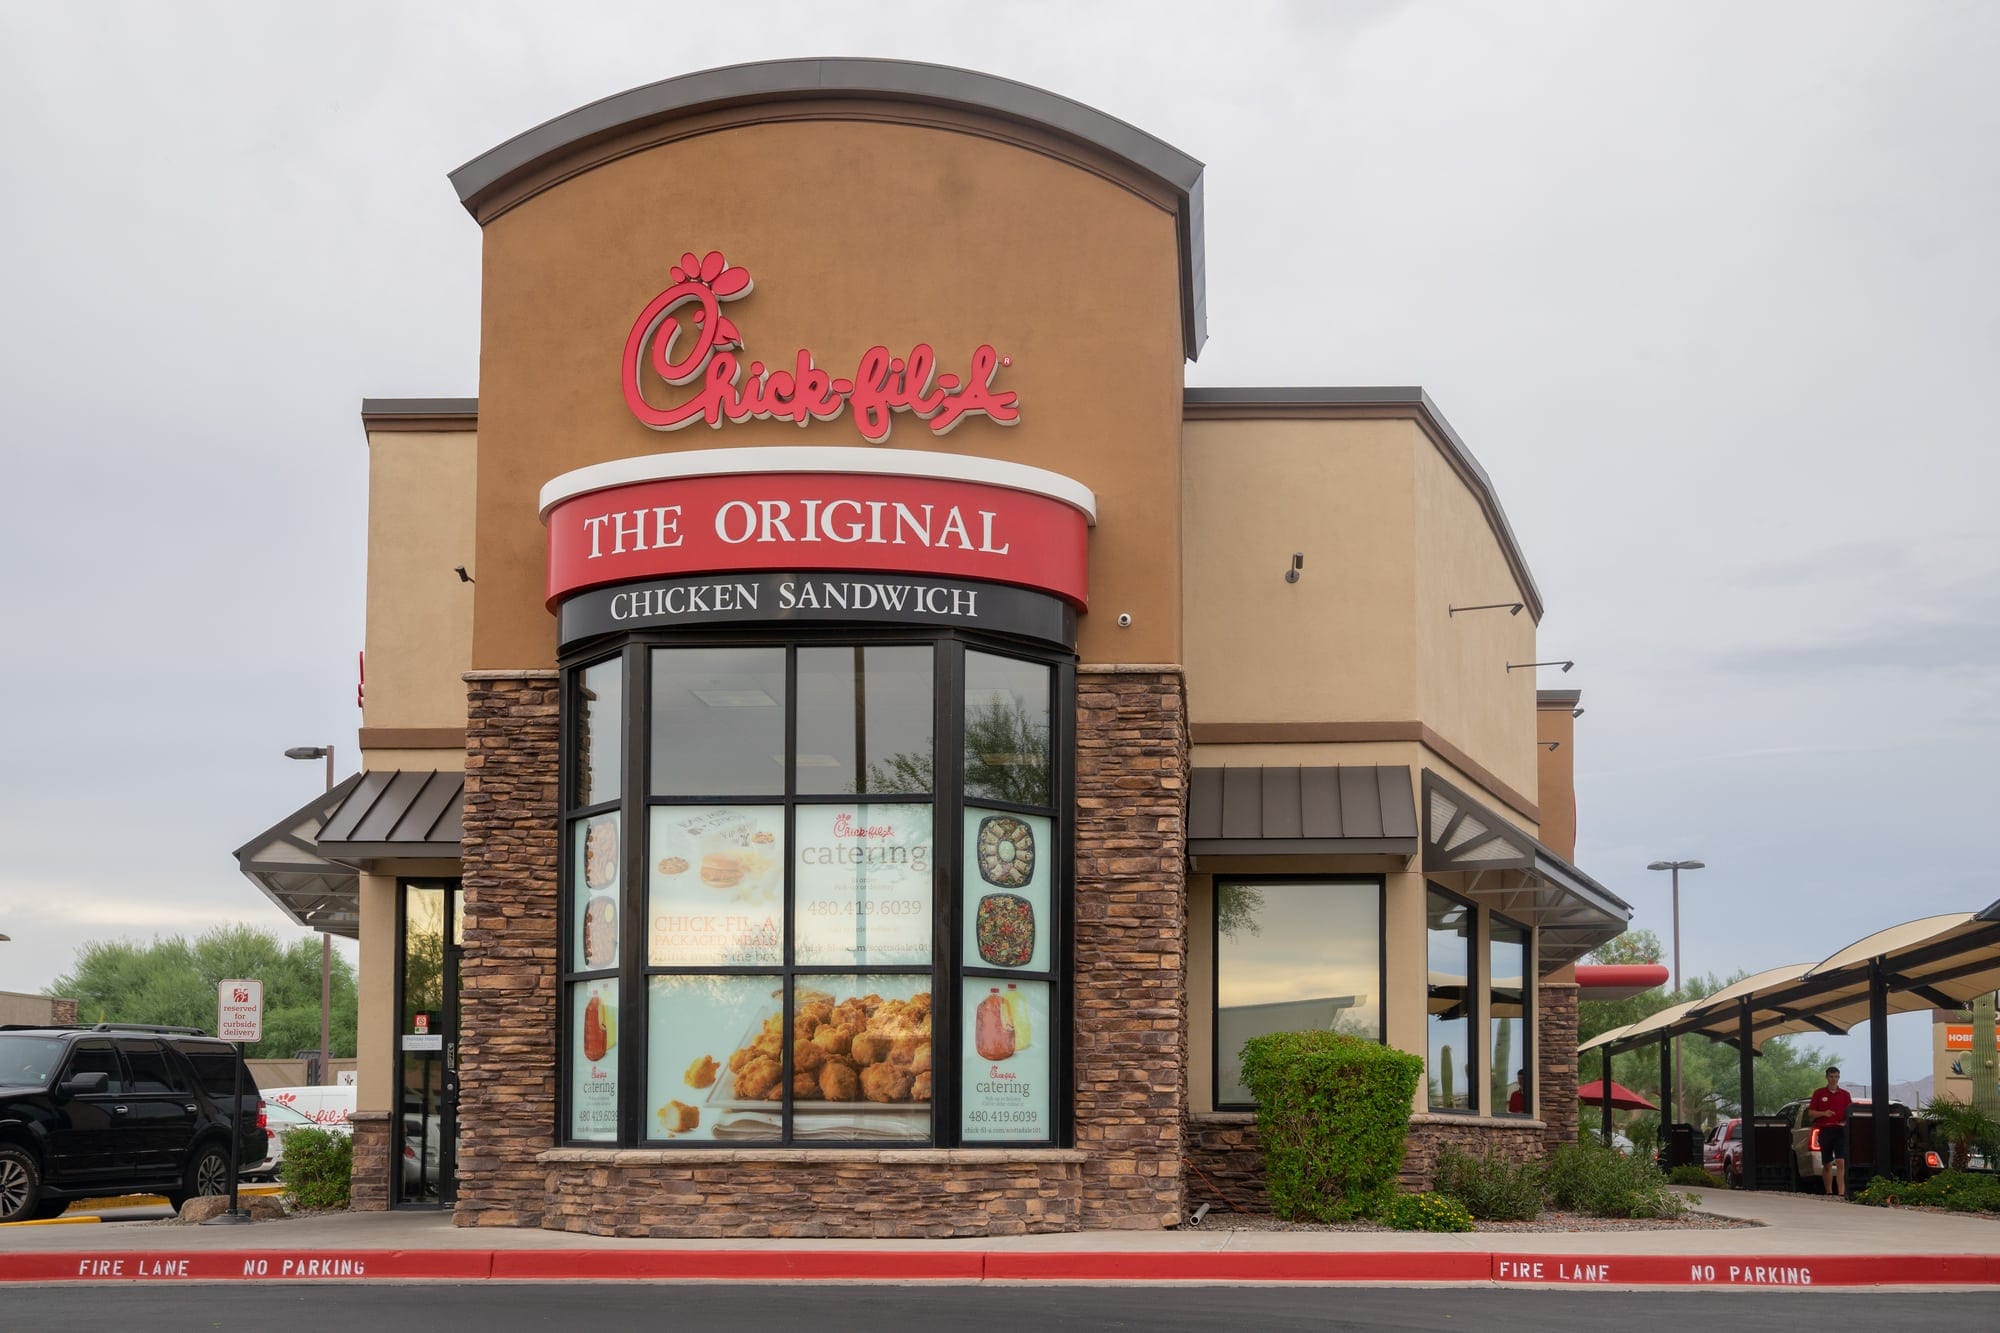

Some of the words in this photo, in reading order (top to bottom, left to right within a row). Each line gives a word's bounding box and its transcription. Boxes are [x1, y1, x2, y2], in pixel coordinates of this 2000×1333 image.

[622, 251, 1020, 444] Chick-fil-A
[583, 504, 685, 559] THE
[714, 499, 1009, 556] ORIGINAL
[610, 582, 759, 620] CHICKEN
[778, 580, 979, 617] SANDWICH
[801, 840, 928, 872] catering
[807, 900, 922, 916] 480.419.6039
[654, 934, 728, 947] PACKAGED
[732, 934, 777, 947] MEALS
[222, 1020, 257, 1028] curbside
[234, 1012, 246, 1020] for
[223, 1028, 256, 1037] delivery
[583, 1079, 615, 1096] catering
[976, 1079, 1030, 1097] catering
[969, 1110, 1037, 1122] 480.419.6039
[79, 1259, 125, 1276] FIRE
[138, 1259, 190, 1277] LANE
[243, 1259, 269, 1276] NO
[281, 1258, 365, 1276] PARKING
[1499, 1261, 1545, 1278] FIRE
[1559, 1262, 1611, 1282] LANE
[1691, 1264, 1716, 1281] NO
[1729, 1265, 1812, 1285] PARKING
